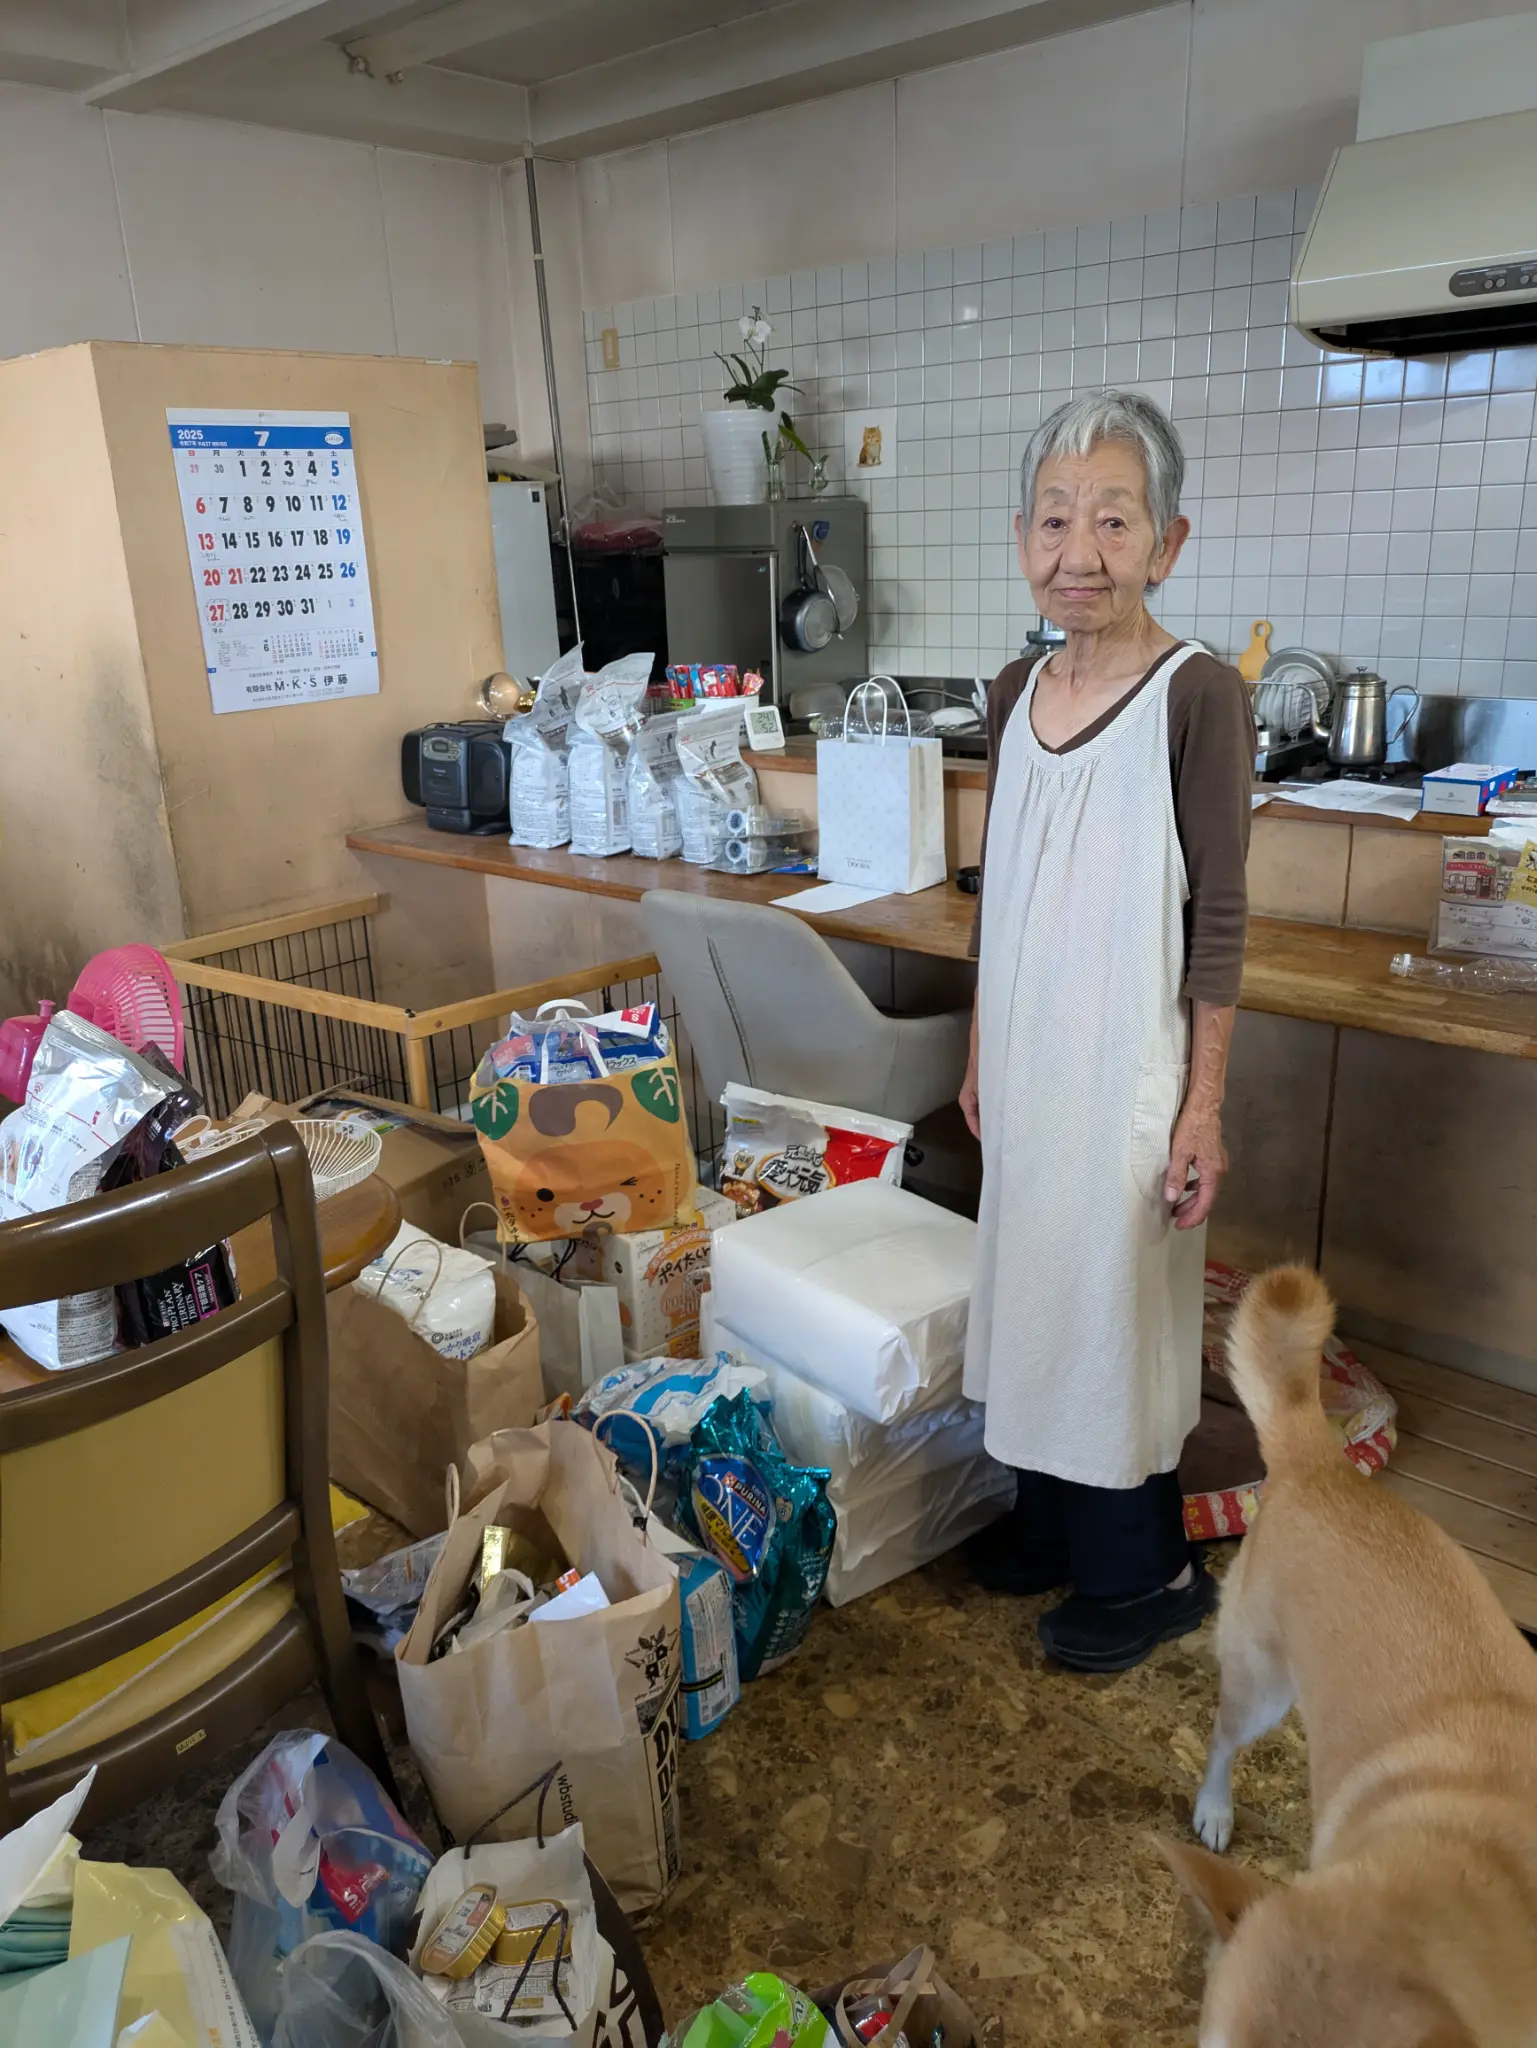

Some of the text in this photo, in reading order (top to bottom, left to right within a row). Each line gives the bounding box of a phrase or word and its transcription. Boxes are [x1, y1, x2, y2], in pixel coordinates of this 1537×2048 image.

[177, 429, 204, 440] 2025
[254, 430, 270, 447] 7
[188, 449, 196, 457] 日
[213, 449, 220, 457] 月
[236, 449, 245, 457] 火
[190, 460, 340, 477] 29 30 1 2 3 4 5
[196, 494, 347, 514] 6 7 8 9 10 11 12
[198, 528, 351, 551] 13 14 15 16 17 18 19
[203, 562, 356, 586] 20 21 22 23 24 25 26
[209, 604, 225, 622] 27
[232, 602, 249, 620] 28
[255, 601, 271, 618] 29
[277, 600, 294, 616] 30
[300, 598, 315, 614] 31
[327, 600, 332, 609] 1
[263, 643, 270, 652] 6
[358, 635, 364, 644] 8
[246, 683, 273, 693] 有限会社
[323, 673, 348, 687] 伊藤
[766, 1158, 826, 1194] 愛犬元気
[164, 1290, 180, 1334] PRO PLAN
[172, 1282, 190, 1329] TERINARY
[185, 1293, 198, 1320] DIETS
[734, 1483, 767, 1515] PURINA
